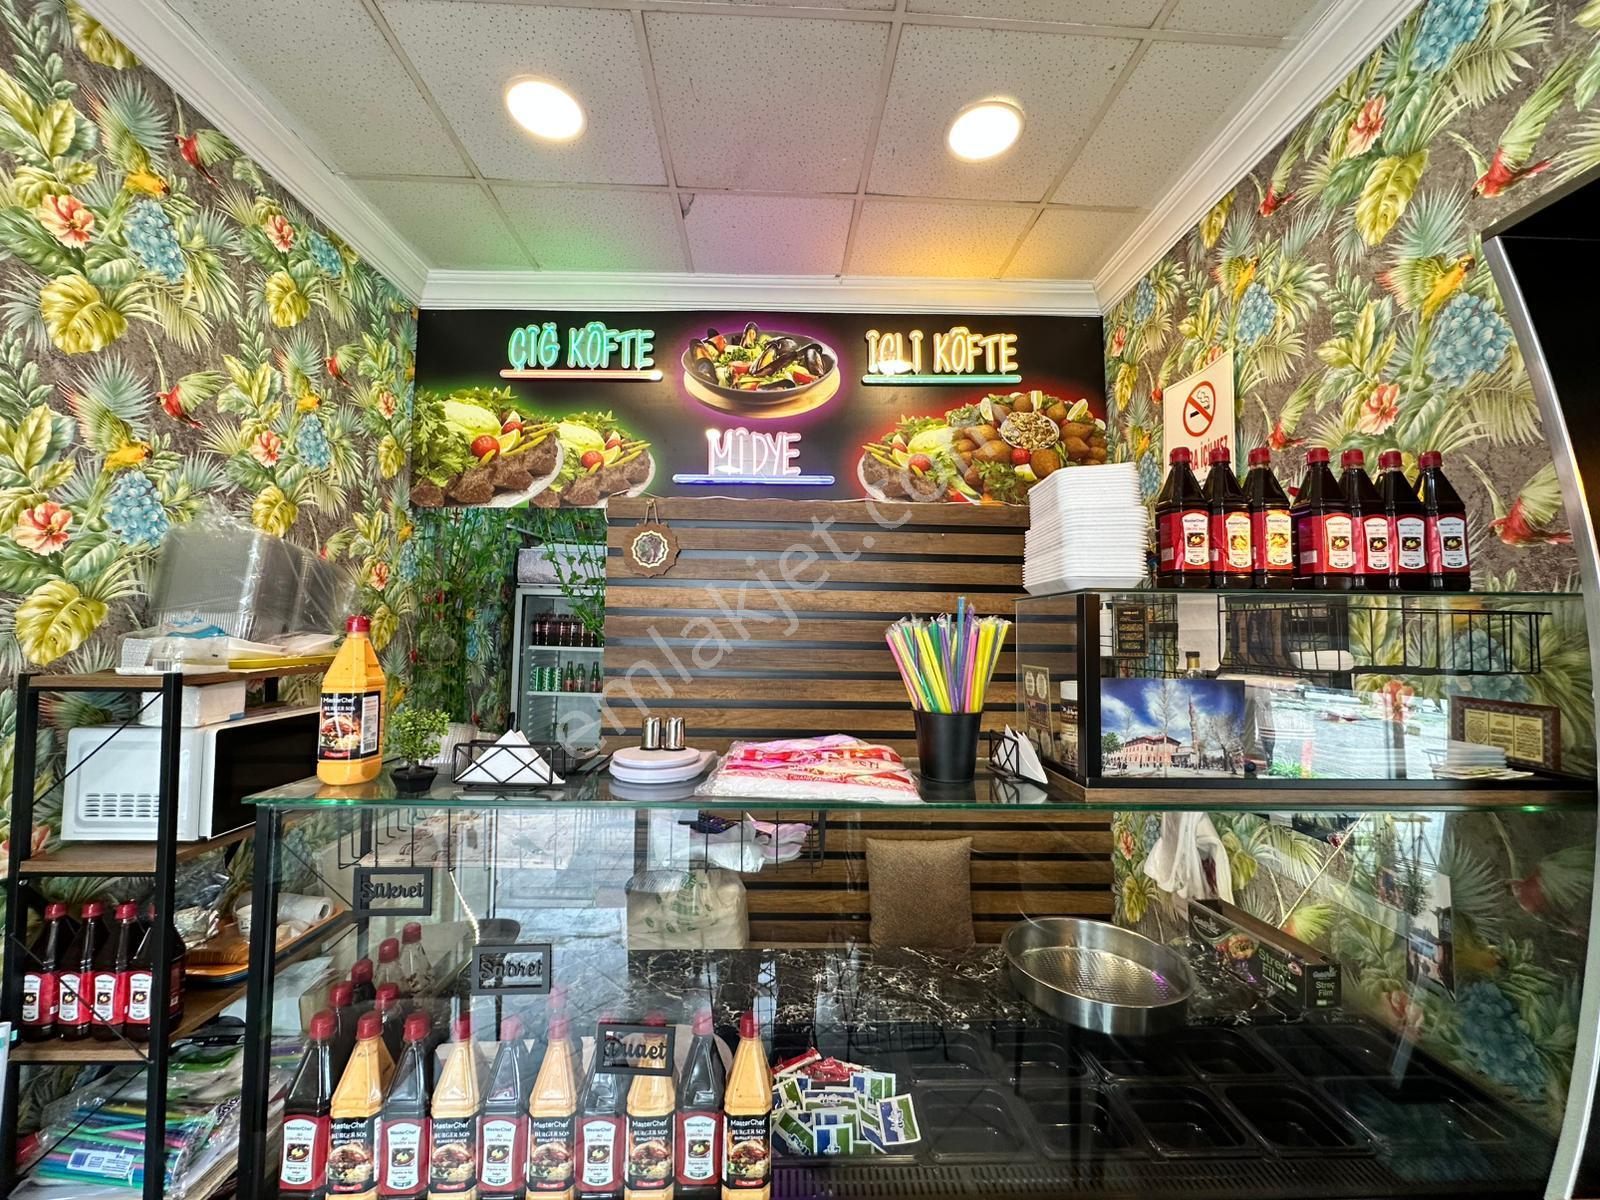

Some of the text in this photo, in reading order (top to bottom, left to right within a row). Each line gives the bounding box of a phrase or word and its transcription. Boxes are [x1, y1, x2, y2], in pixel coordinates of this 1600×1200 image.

[567, 321, 655, 370] KÖFTE
[932, 326, 1019, 374] KÖFTE
[705, 426, 802, 476] MİDYE
[1258, 948, 1292, 977] Streç
[1262, 961, 1285, 986] Film
